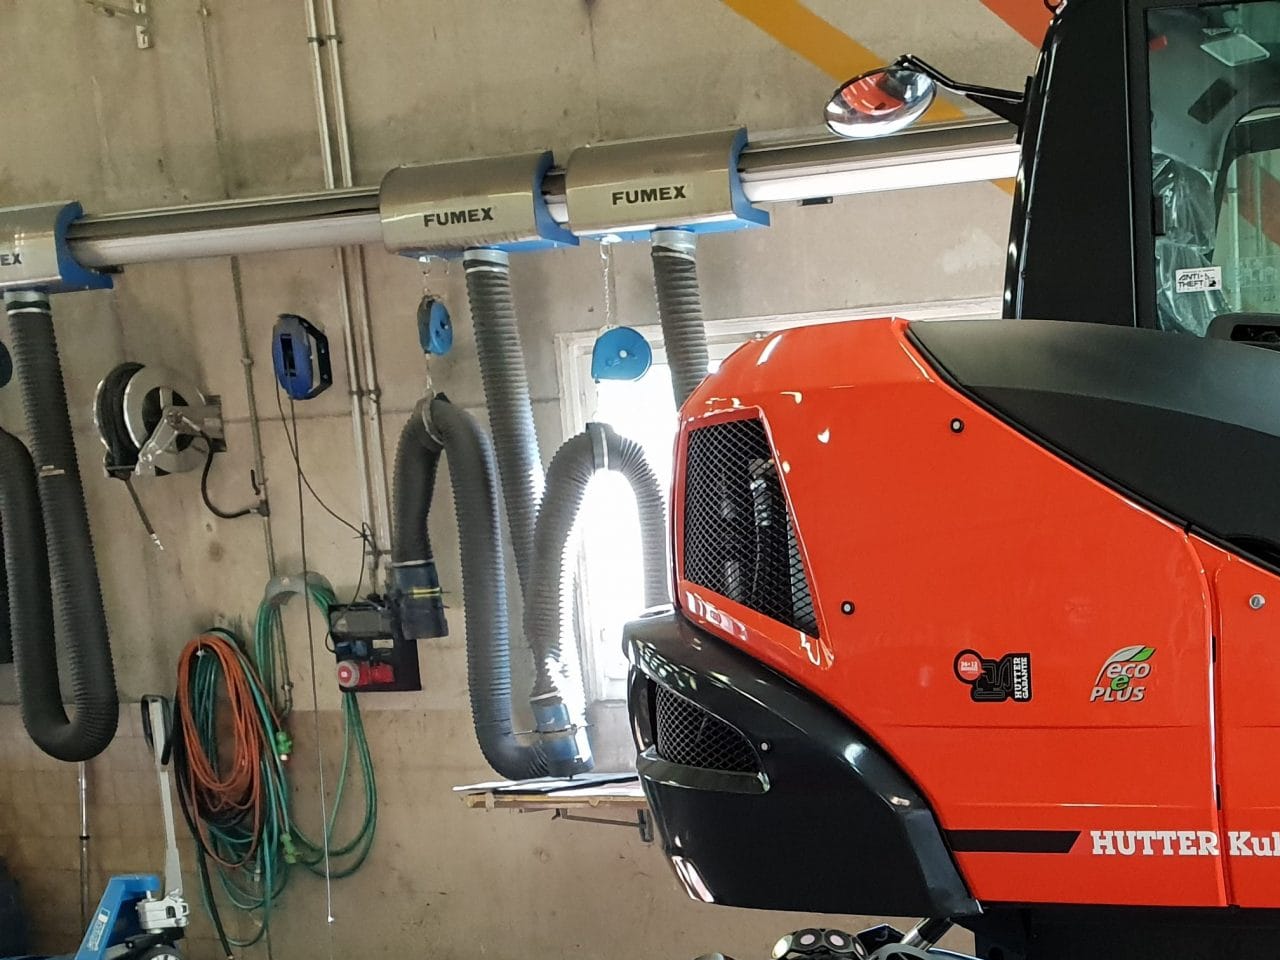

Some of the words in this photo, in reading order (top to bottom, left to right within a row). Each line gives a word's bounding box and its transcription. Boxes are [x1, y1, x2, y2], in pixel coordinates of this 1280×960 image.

[611, 184, 687, 206] FUMEX
[422, 206, 494, 228] FUMEX
[1013, 656, 1022, 699] HUTTER
[1020, 656, 1029, 699] GARANTIE
[1106, 662, 1151, 679] eco
[1089, 686, 1146, 702] PLUS
[1089, 829, 1219, 856] HUTTER
